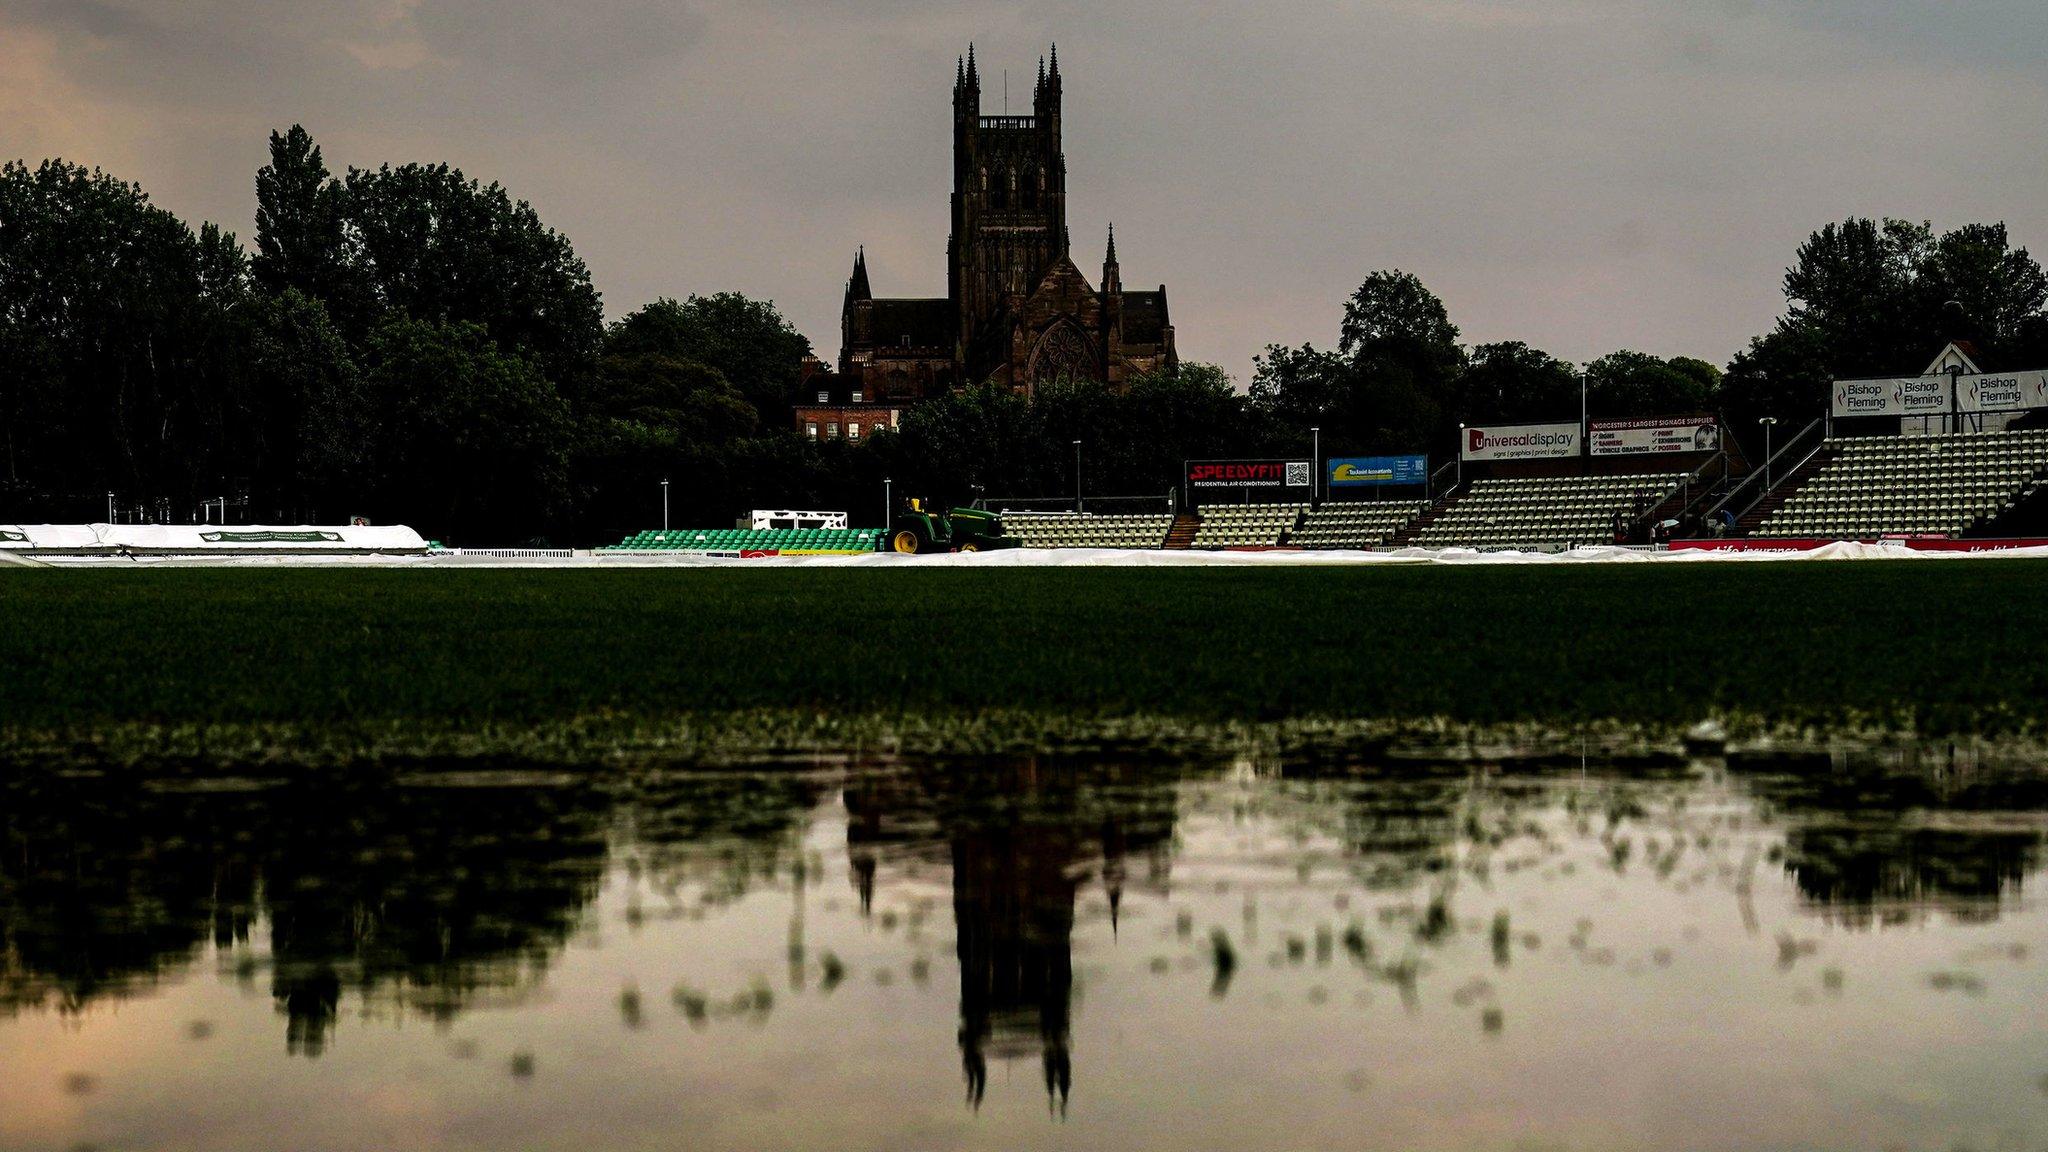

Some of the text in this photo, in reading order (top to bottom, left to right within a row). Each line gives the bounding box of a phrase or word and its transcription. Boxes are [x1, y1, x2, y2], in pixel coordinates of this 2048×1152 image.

[1904, 382, 1939, 393] Bishop
[1980, 378, 2017, 389] Bishop
[1847, 384, 1882, 396] Bishop
[1980, 390, 2021, 401] Fleming
[1847, 397, 1886, 409] Fleming
[1904, 394, 1943, 405] Fleming
[1592, 421, 1632, 430] WORCESTER'S
[1633, 420, 1659, 428] LARGEST
[1687, 417, 1714, 425] SUPPLIER
[1509, 449, 1531, 458] graphics
[1551, 448, 1569, 456] design
[1190, 464, 1284, 480] SPEEDYFIT
